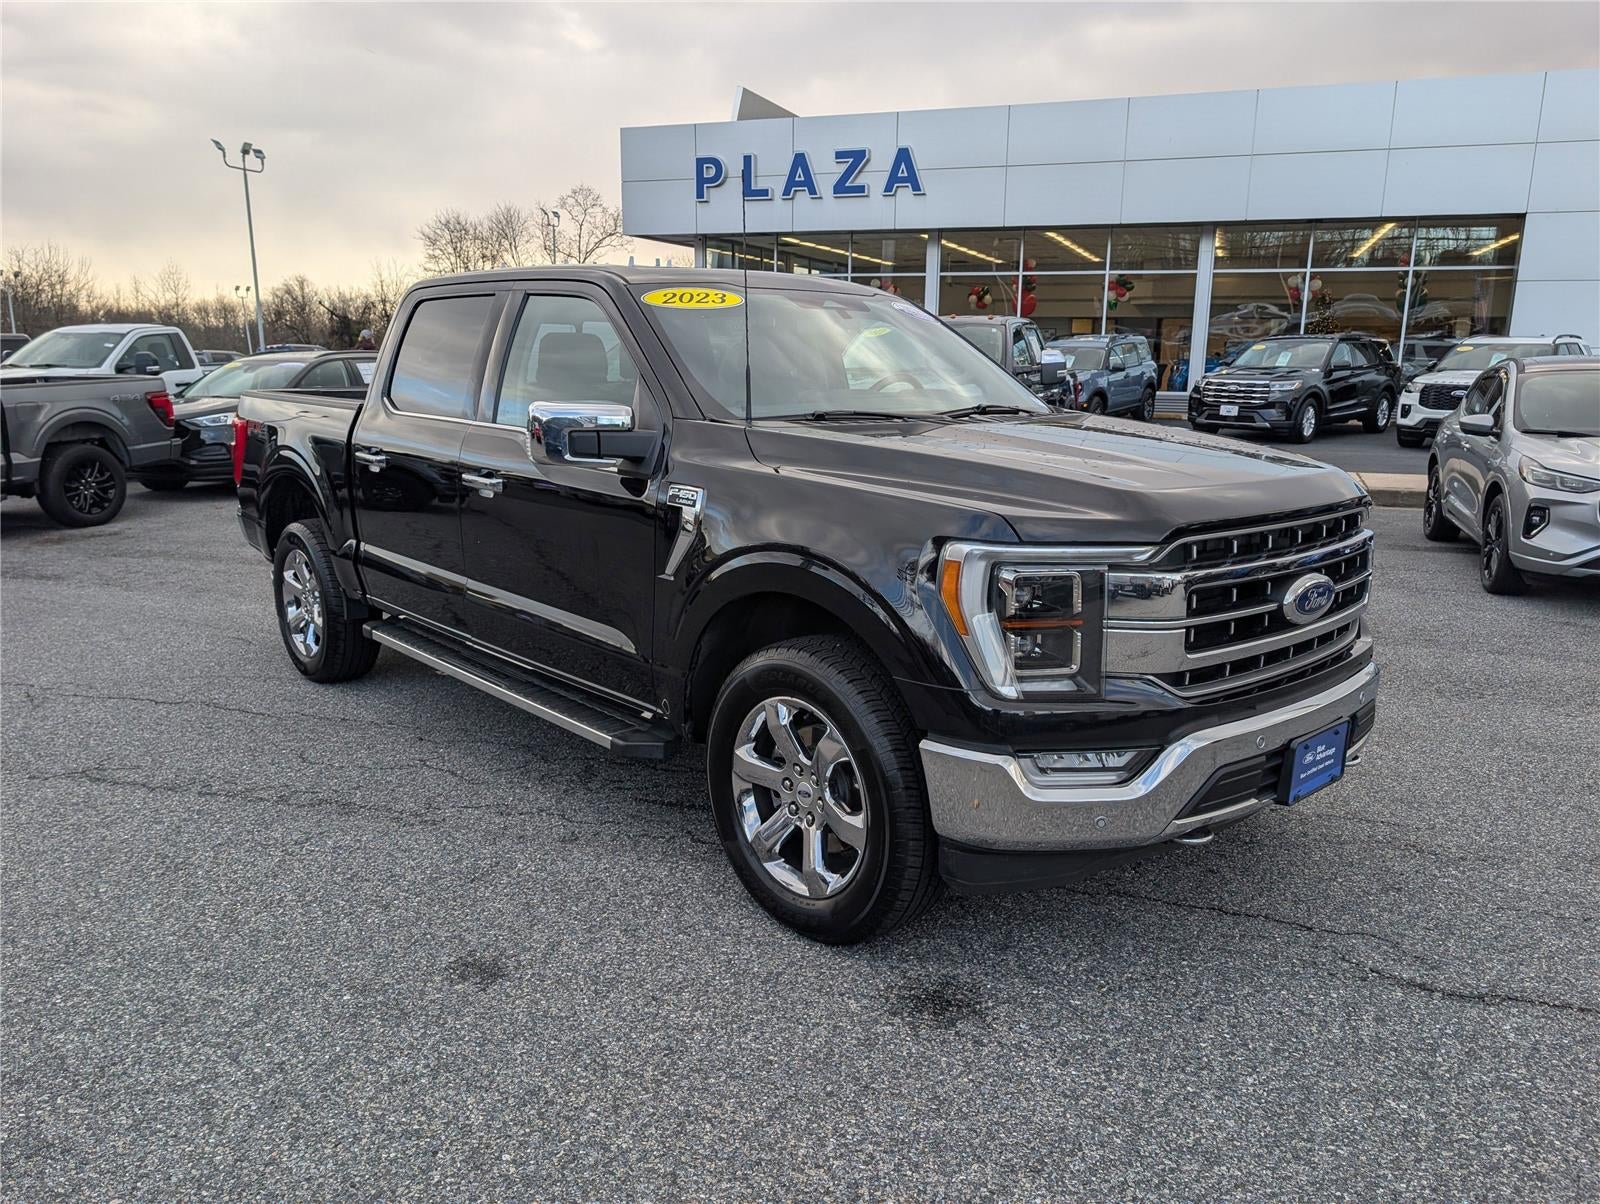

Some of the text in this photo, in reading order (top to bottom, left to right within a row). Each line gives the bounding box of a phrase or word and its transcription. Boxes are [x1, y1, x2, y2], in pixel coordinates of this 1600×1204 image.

[695, 146, 924, 201] PLAZA
[662, 291, 727, 304] 2023
[669, 488, 697, 500] F-150
